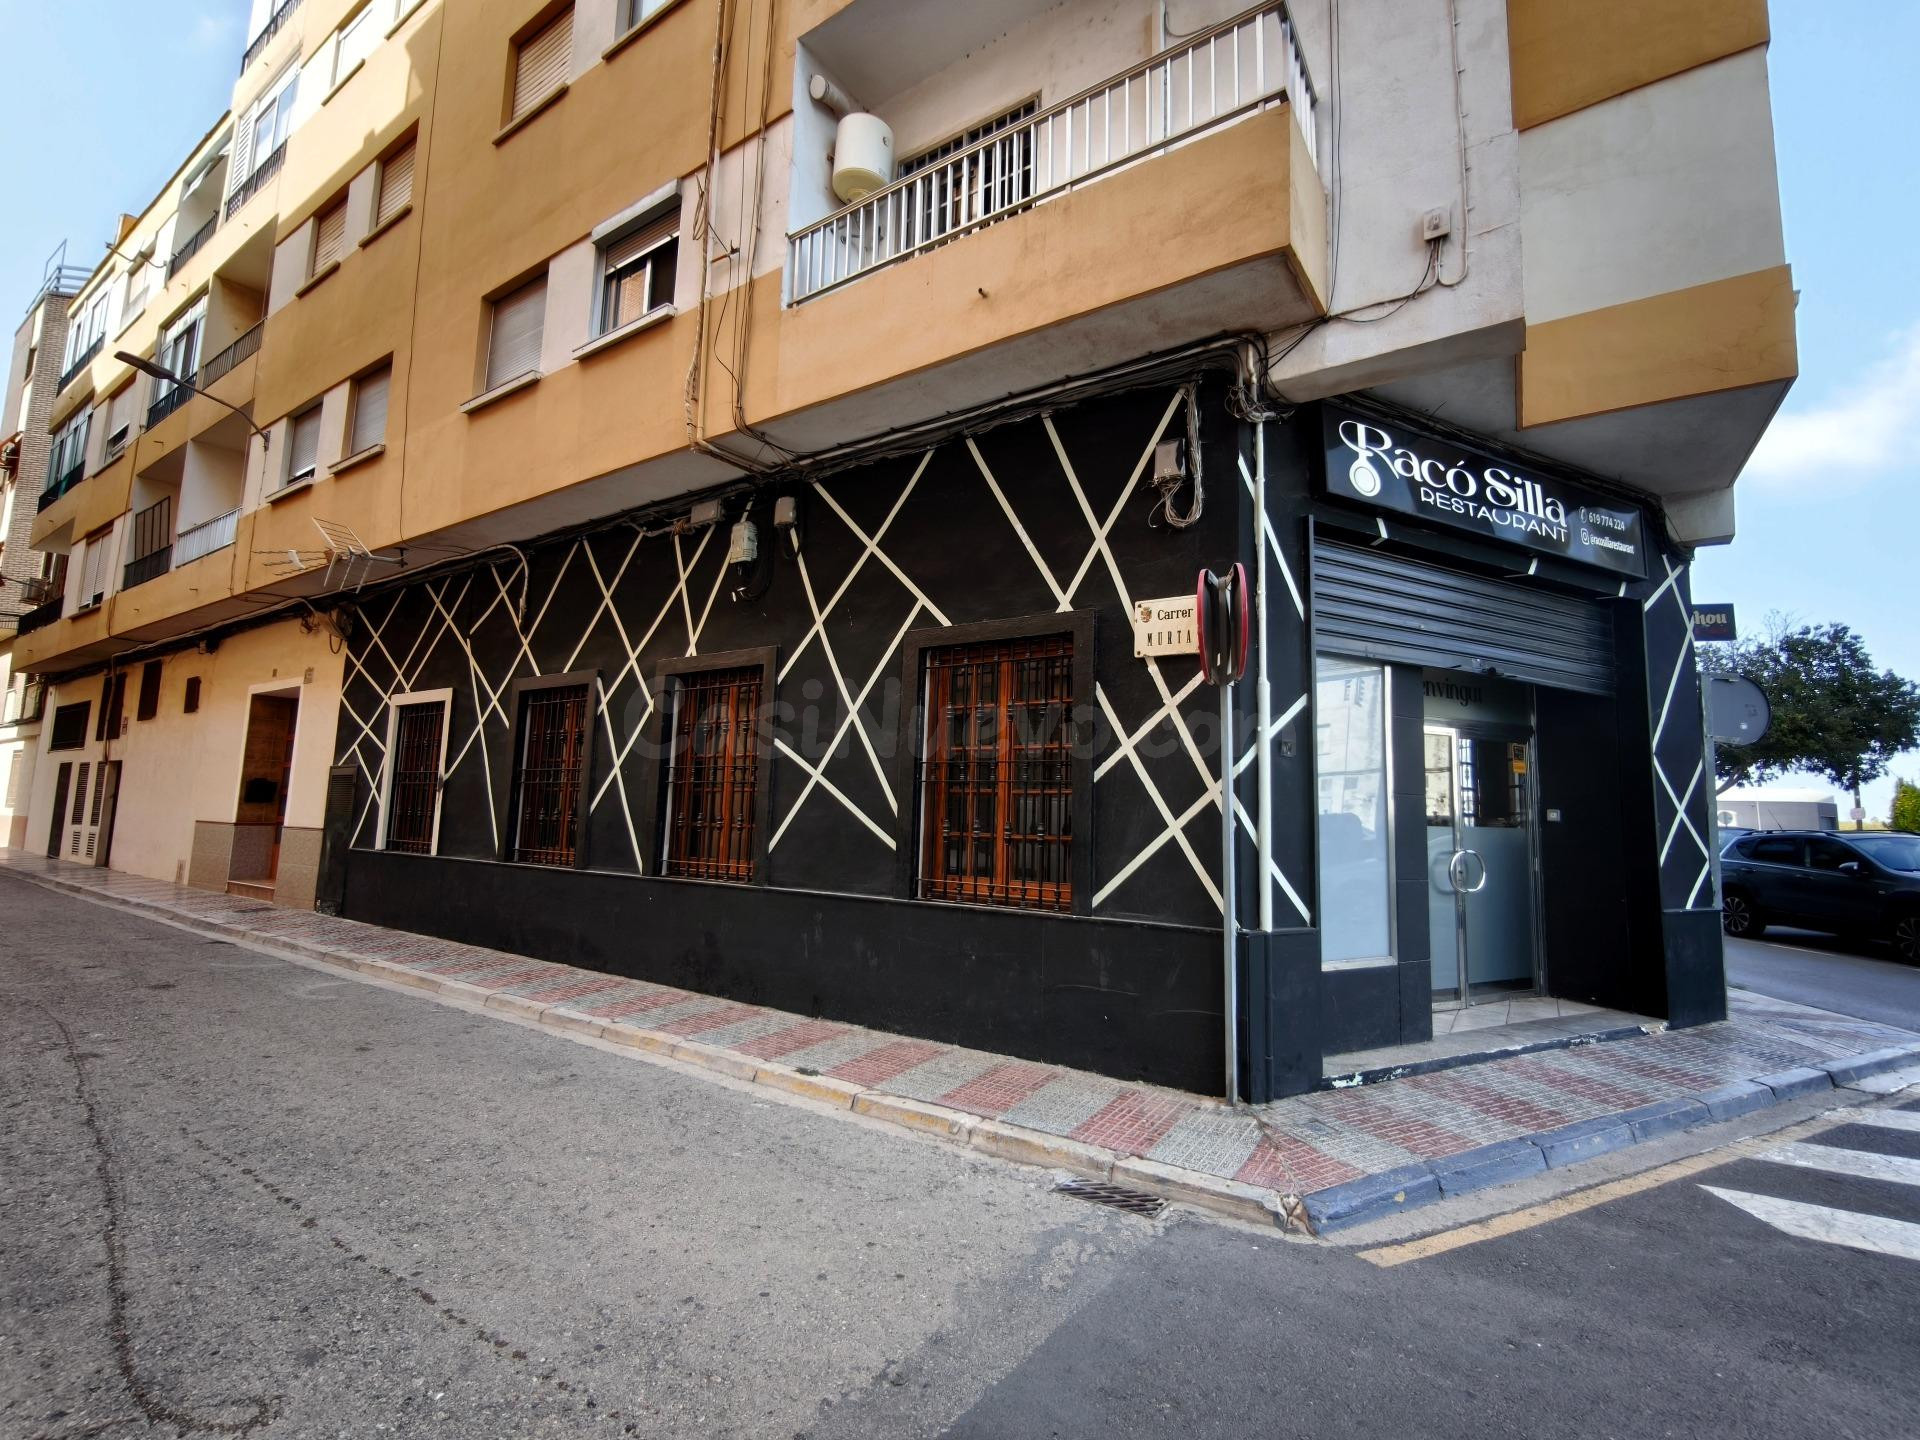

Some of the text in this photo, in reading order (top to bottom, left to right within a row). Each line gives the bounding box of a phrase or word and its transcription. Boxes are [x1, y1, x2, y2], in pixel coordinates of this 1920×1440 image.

[1339, 420, 1568, 527] Racó Silla
[1420, 486, 1568, 543] RESTAURANT
[1588, 512, 1626, 532] 619 774 224
[1157, 608, 1194, 621] Carrer
[1693, 610, 1728, 625] hou
[1147, 629, 1192, 647] MURTA
